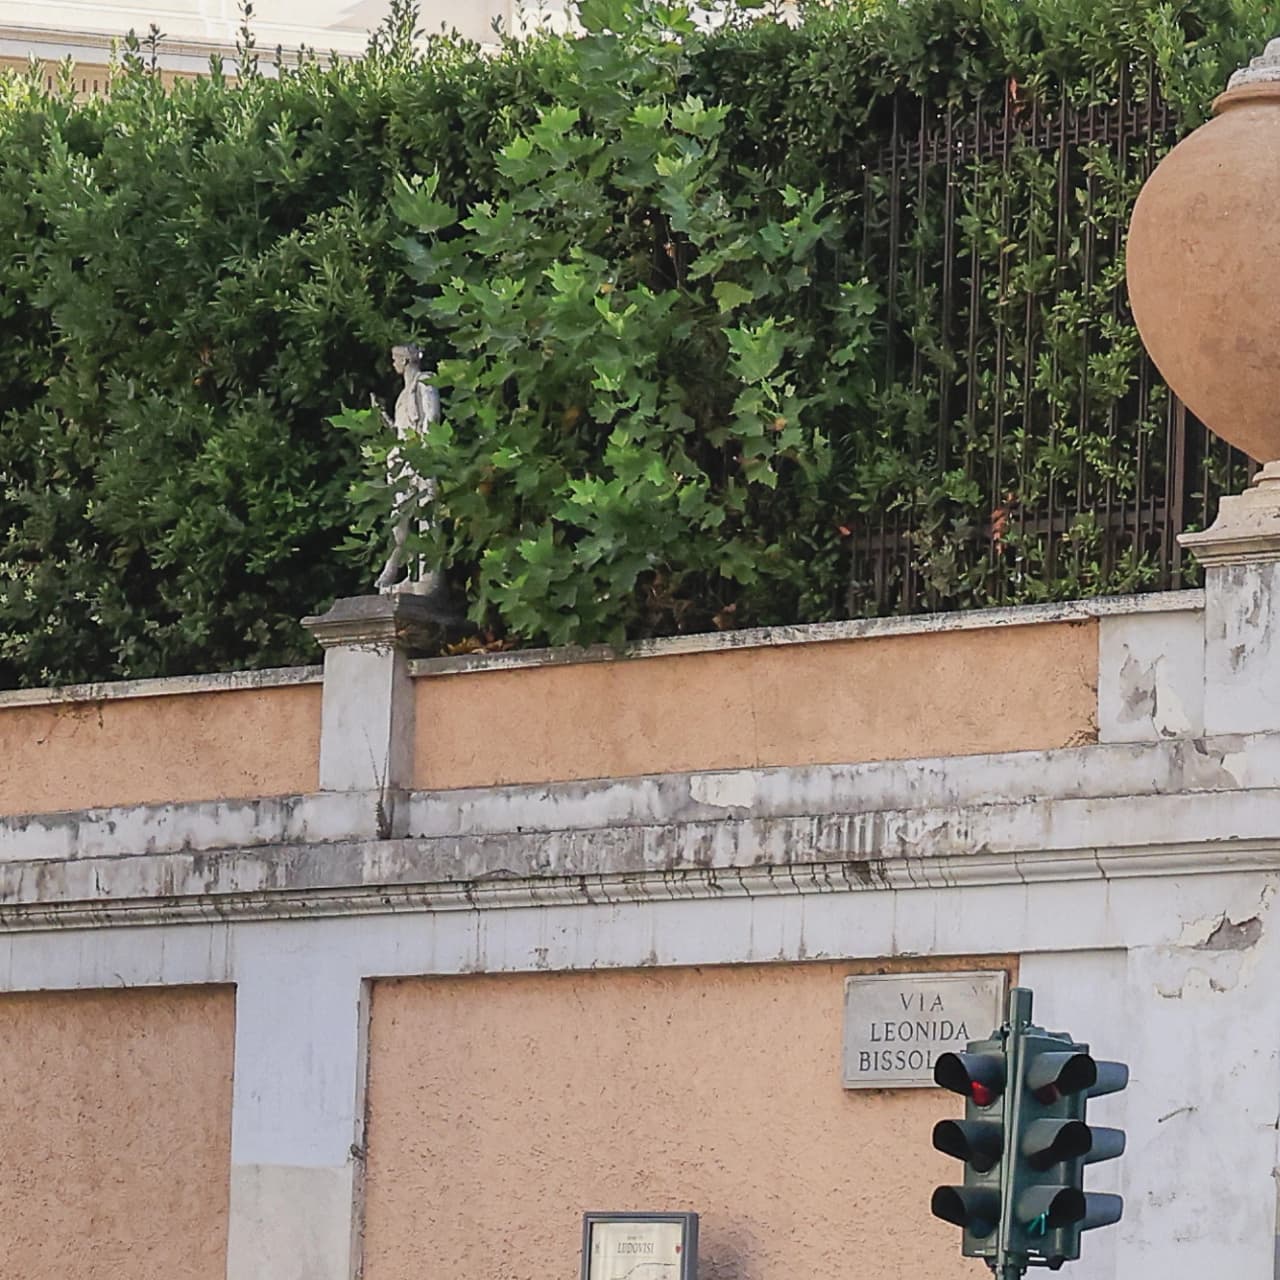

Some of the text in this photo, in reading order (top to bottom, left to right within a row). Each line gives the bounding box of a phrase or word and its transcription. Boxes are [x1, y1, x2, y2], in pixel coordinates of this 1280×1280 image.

[900, 992, 944, 1012] VIA
[869, 1020, 970, 1042] LEONIDA
[858, 1050, 936, 1072] BISSOL
